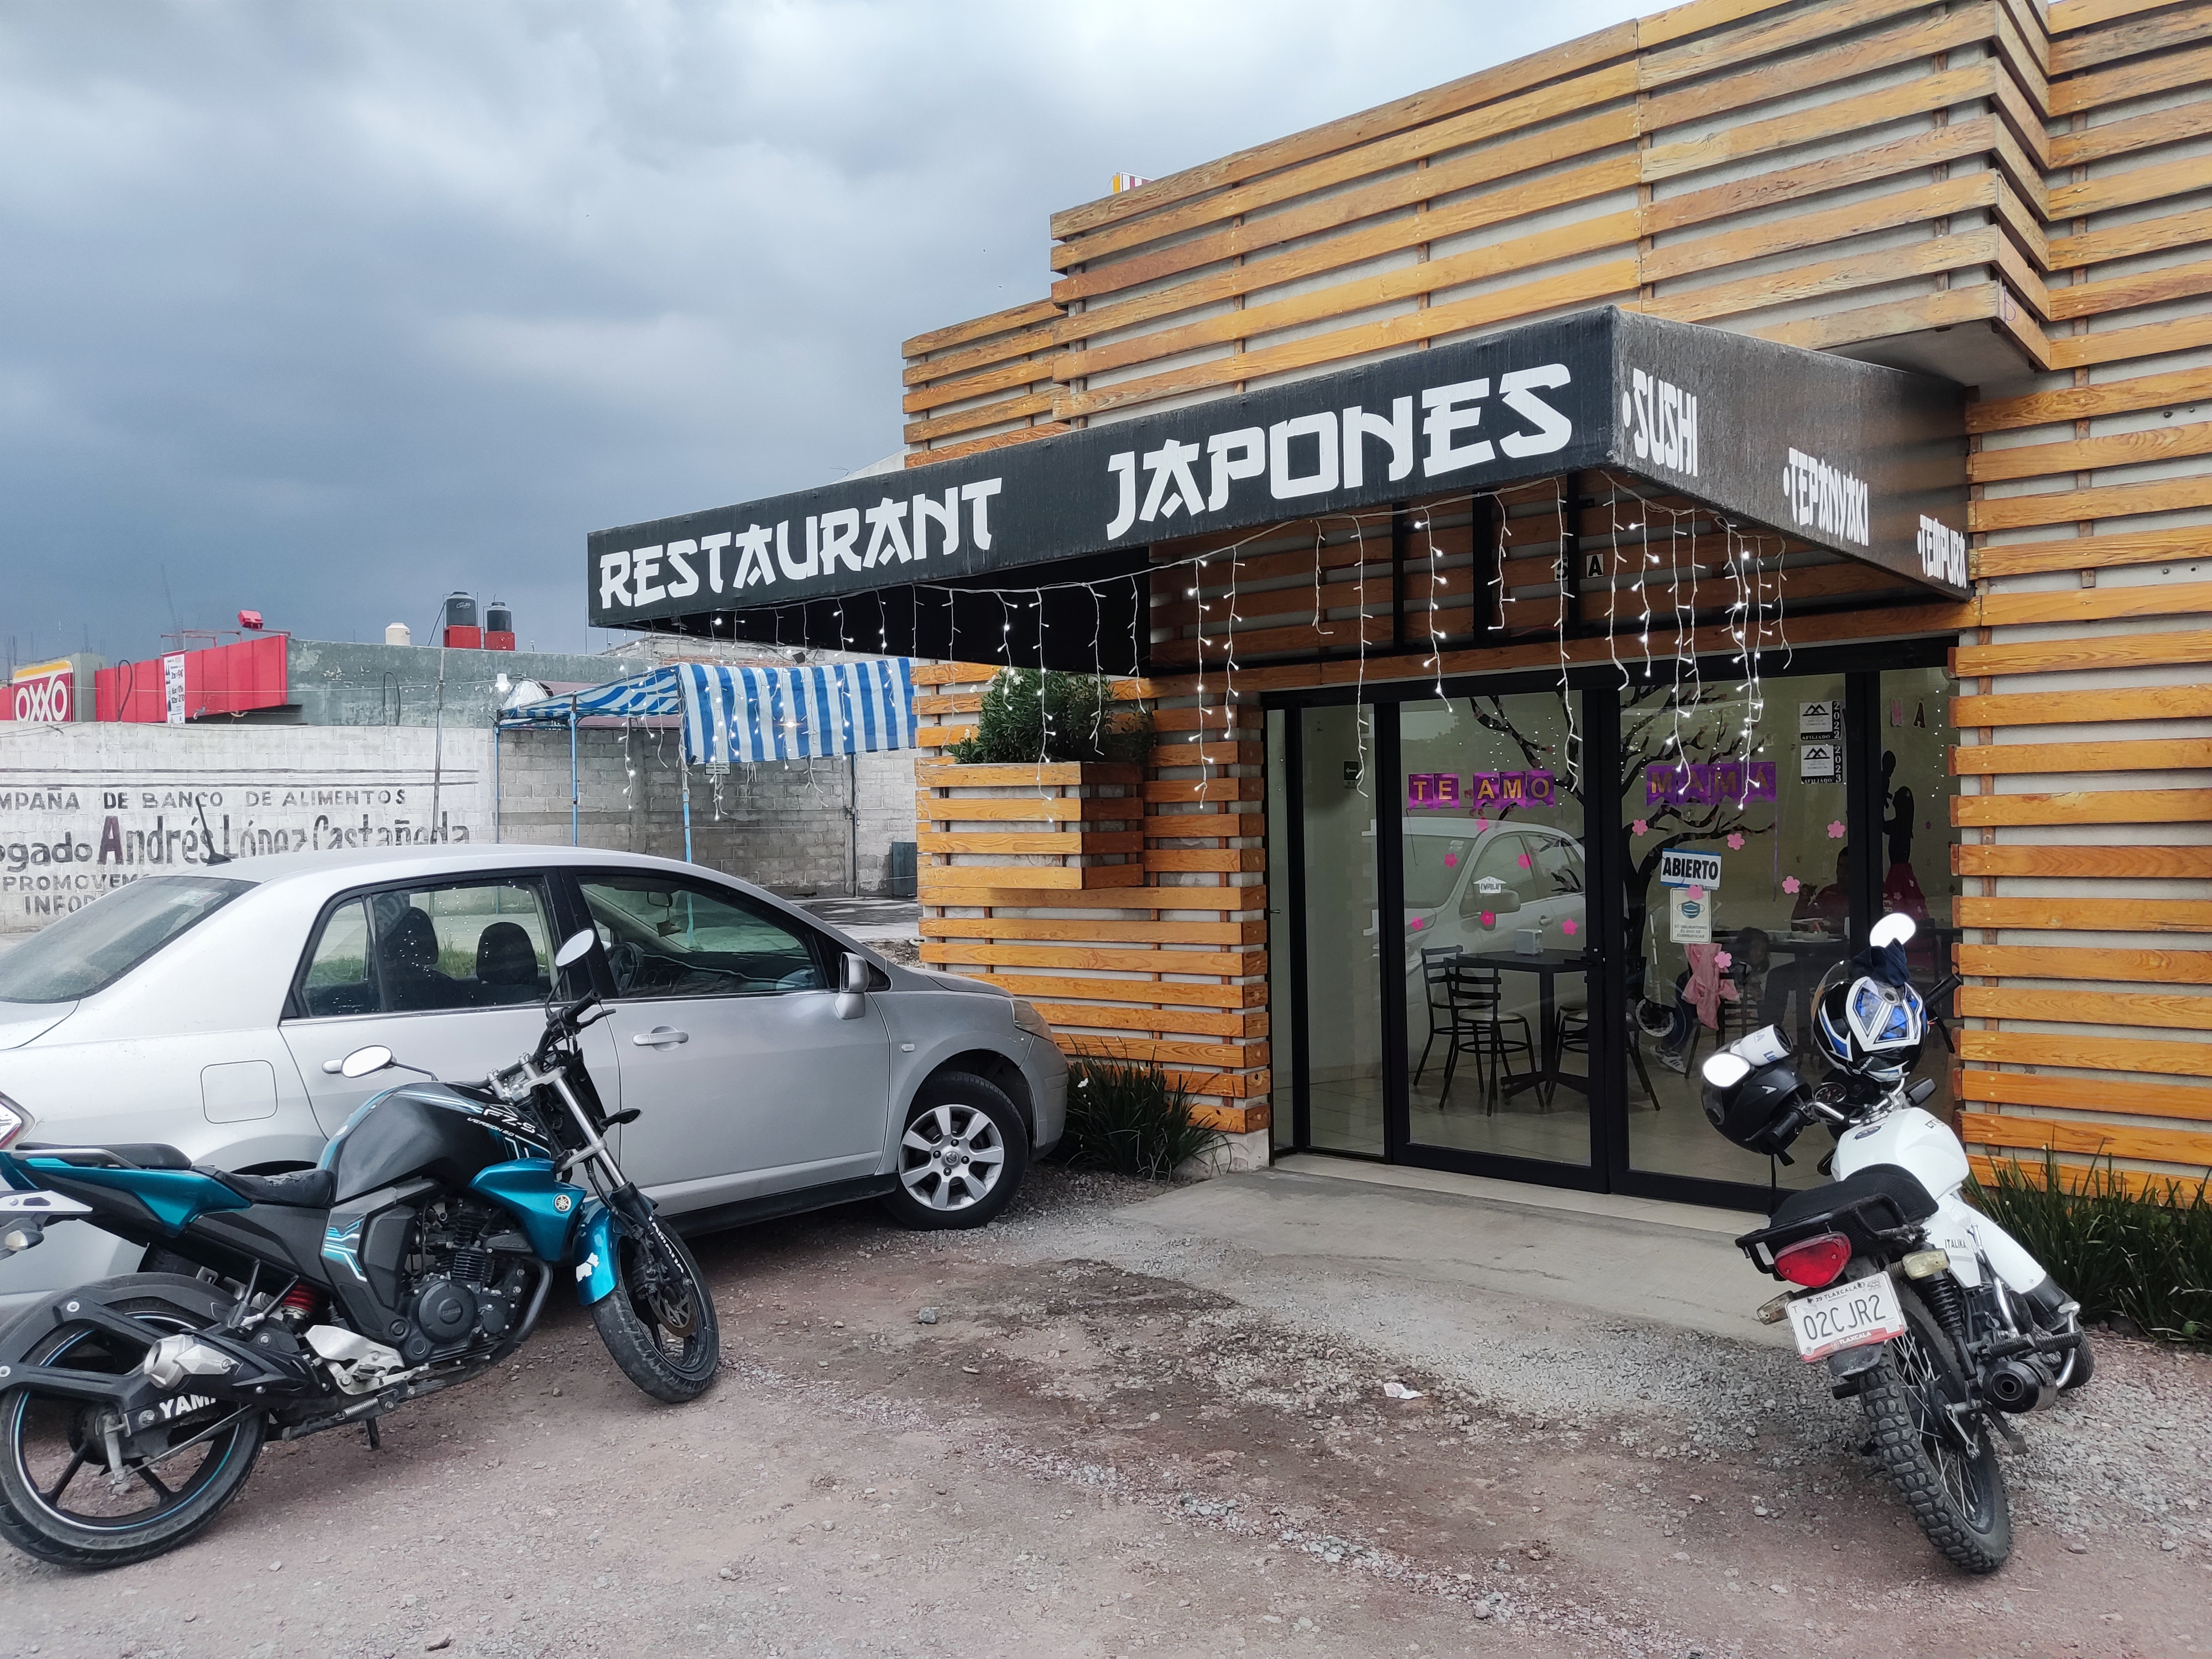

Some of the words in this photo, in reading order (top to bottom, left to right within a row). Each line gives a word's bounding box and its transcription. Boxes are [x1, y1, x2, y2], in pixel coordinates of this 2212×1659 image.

[1632, 367, 1698, 477] SUSHI
[1107, 363, 1572, 540] JAPONES
[1788, 447, 1869, 546] TEPANYAKI
[599, 477, 1003, 609] RESTAURANT
[1919, 514, 1967, 589] TEMPURA
[1588, 555, 1603, 577] A
[15, 680, 67, 722] OXXO
[103, 792, 130, 809] DE
[142, 791, 223, 808] BANCO
[246, 790, 273, 807] DE
[281, 789, 406, 807] ALIMENTOS
[1413, 780, 1453, 801] TE
[1477, 778, 1550, 800] AMO
[1662, 857, 1719, 880] ABIERTO
[467, 1117, 503, 1132] VERSION
[483, 1108, 536, 1134] FZ-S
[1944, 1239, 1968, 1249] ITALIKA
[1824, 1285, 1858, 1300] TLAXCALA
[1838, 1331, 1872, 1345] TLAXCALA
